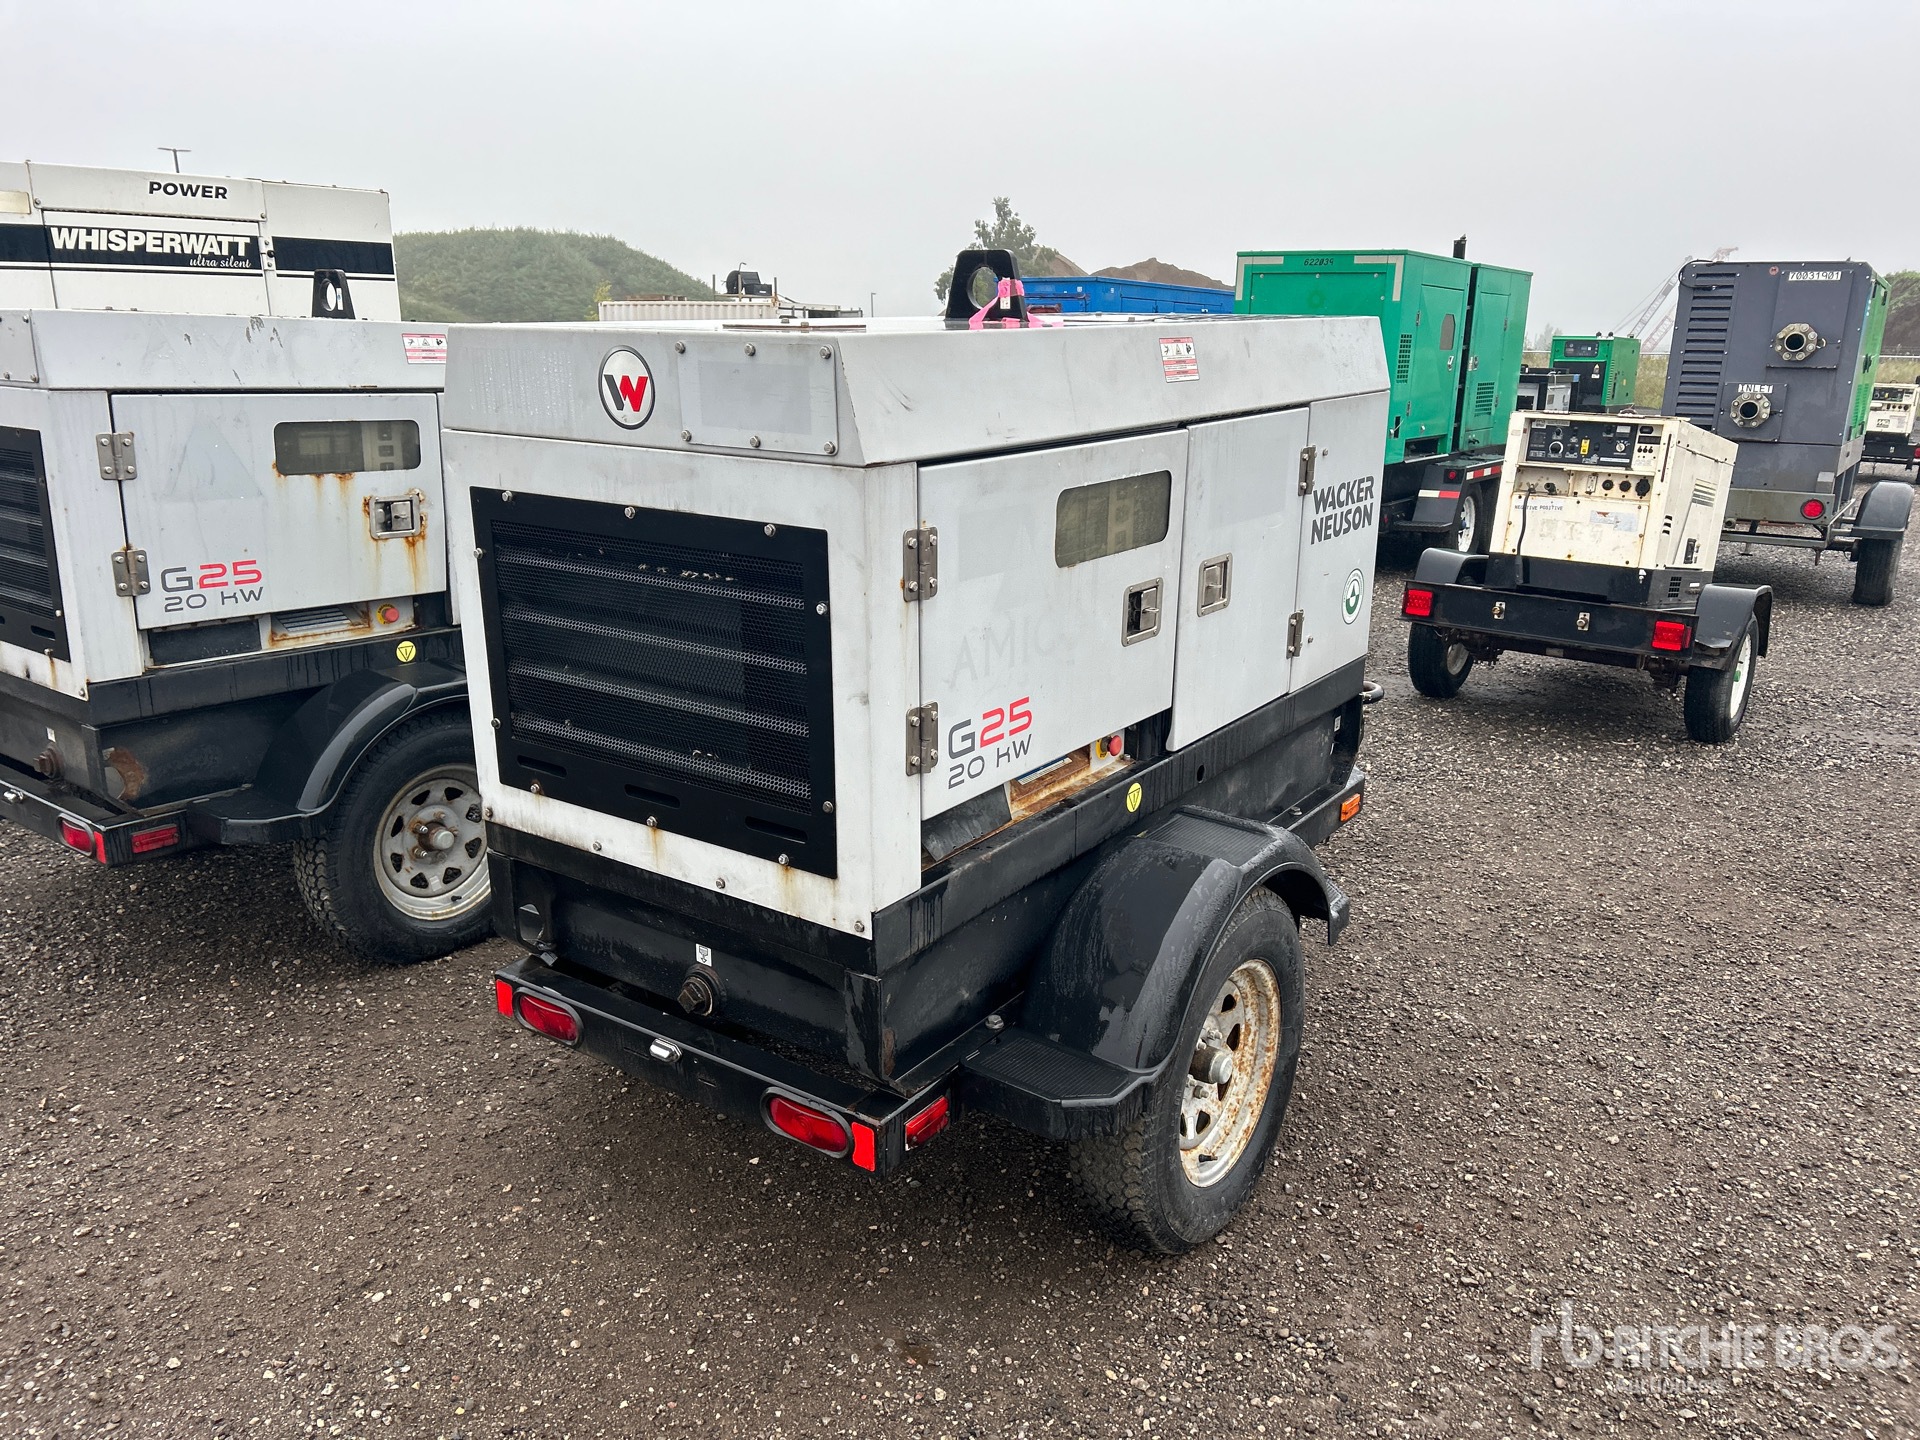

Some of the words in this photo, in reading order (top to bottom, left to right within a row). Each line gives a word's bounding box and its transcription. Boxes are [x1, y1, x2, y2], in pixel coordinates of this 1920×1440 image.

[149, 181, 228, 200] POWER
[50, 226, 250, 257] WHISPERWATT
[189, 255, 218, 268] ultra
[219, 257, 251, 268] silent
[603, 374, 649, 412] W
[1739, 384, 1773, 393] INLET
[1312, 475, 1375, 515] WACKER
[1310, 502, 1374, 545] NEUSON
[160, 559, 262, 593] G25
[164, 593, 207, 613] 20
[948, 696, 1033, 760] G25
[948, 755, 985, 790] 20
